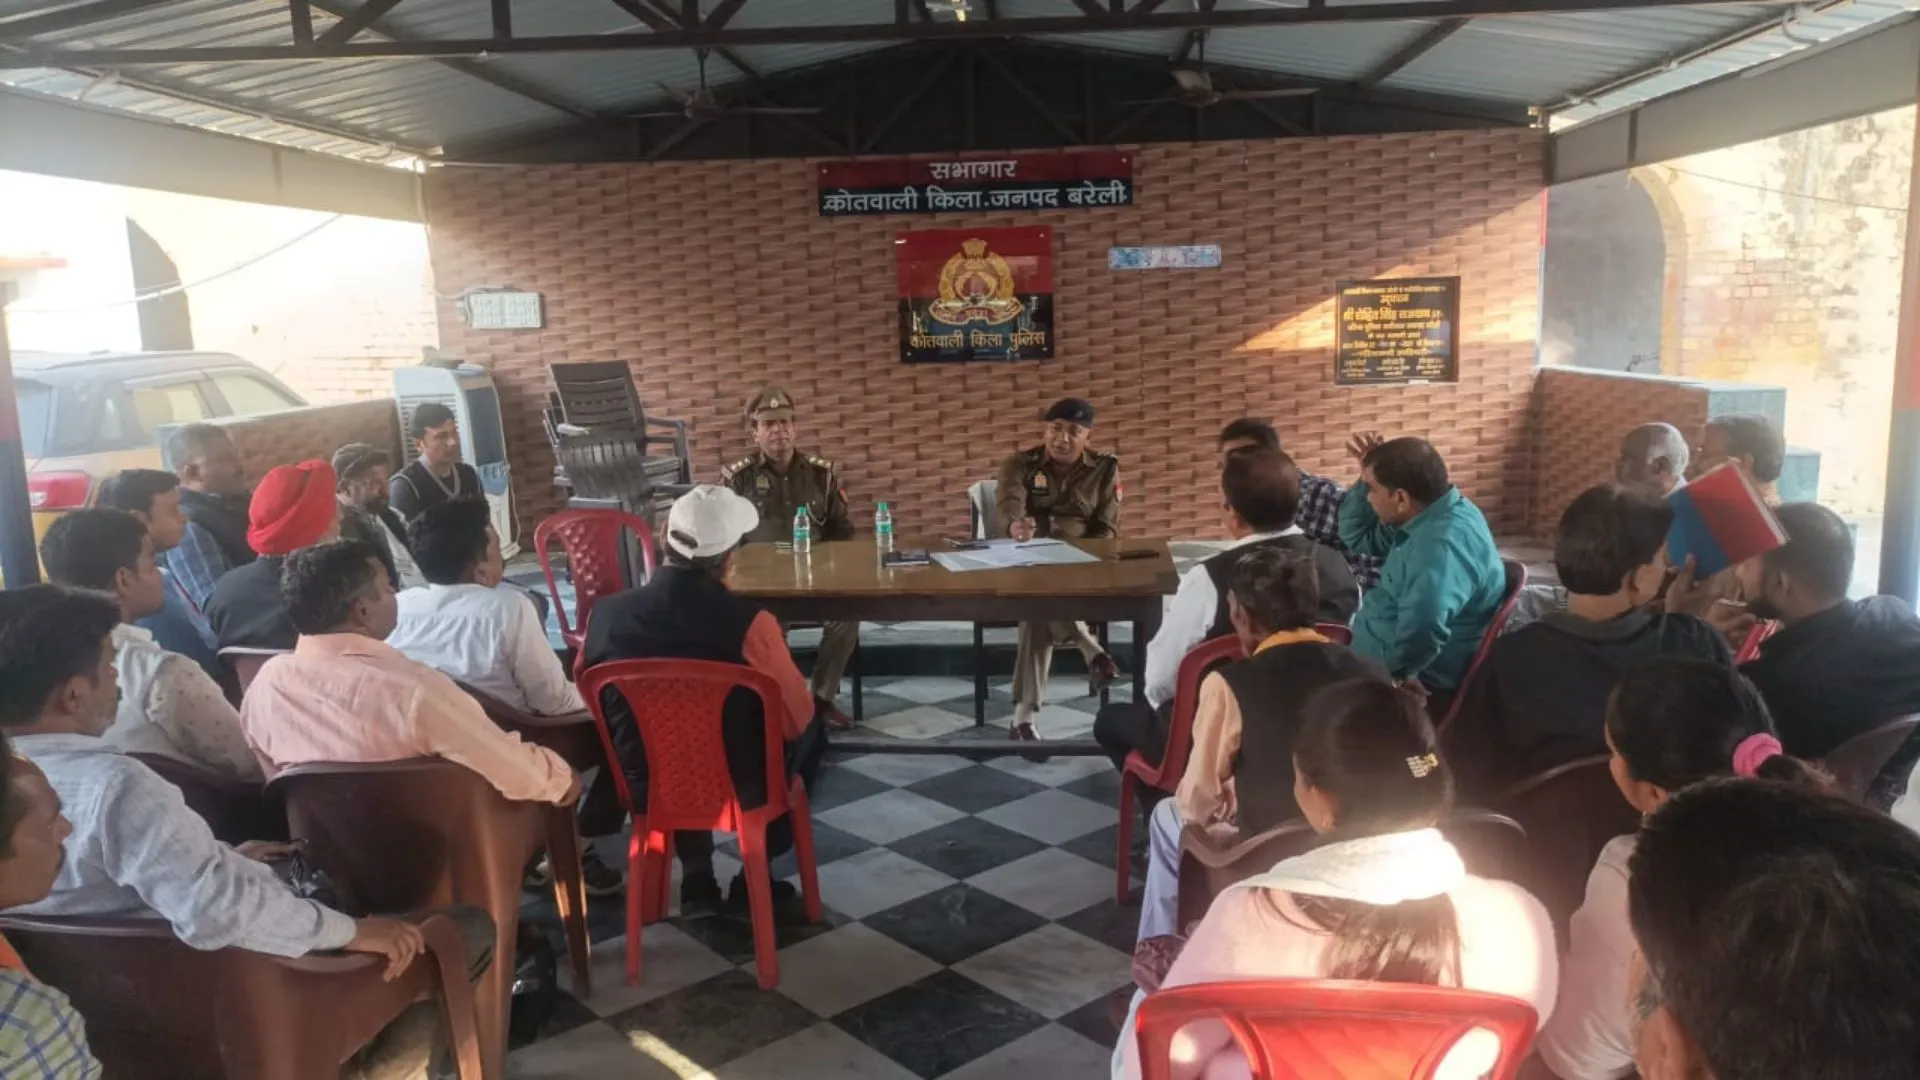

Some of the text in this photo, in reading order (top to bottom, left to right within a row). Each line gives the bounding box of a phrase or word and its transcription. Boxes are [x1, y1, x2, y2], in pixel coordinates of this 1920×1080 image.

[929, 161, 1018, 180] सभागार
[910, 328, 1046, 352] कोतवाली किला पुलिस
